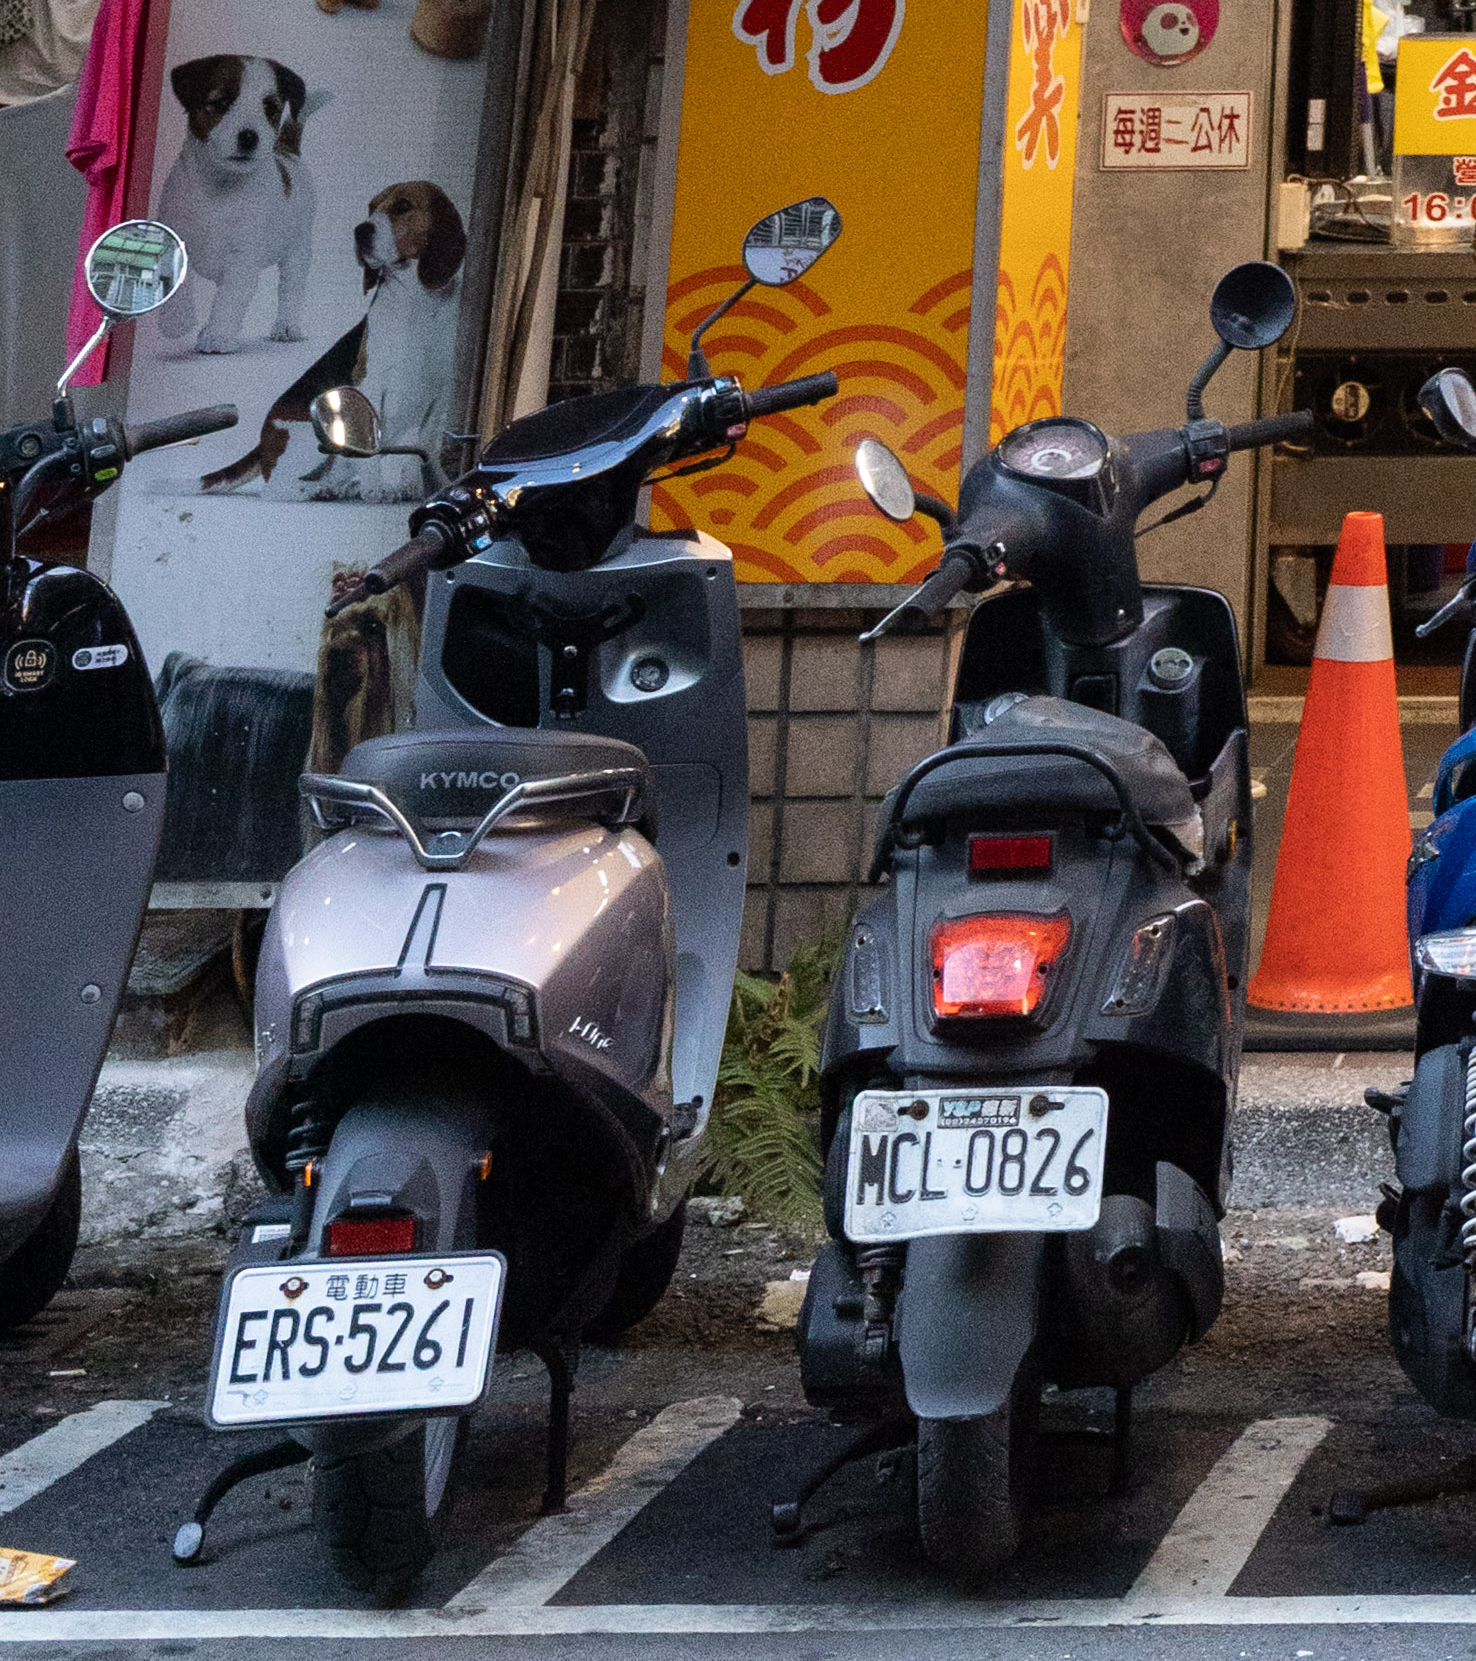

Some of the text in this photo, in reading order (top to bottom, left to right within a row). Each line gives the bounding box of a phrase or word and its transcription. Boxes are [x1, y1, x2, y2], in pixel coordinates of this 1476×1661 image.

[1112, 105, 1242, 155] 每週二公休
[419, 770, 522, 790] KYMCO
[855, 1127, 1095, 1206] MCL-0826
[324, 1271, 409, 1301] 電動車
[229, 1294, 472, 1383] ERS-5261
